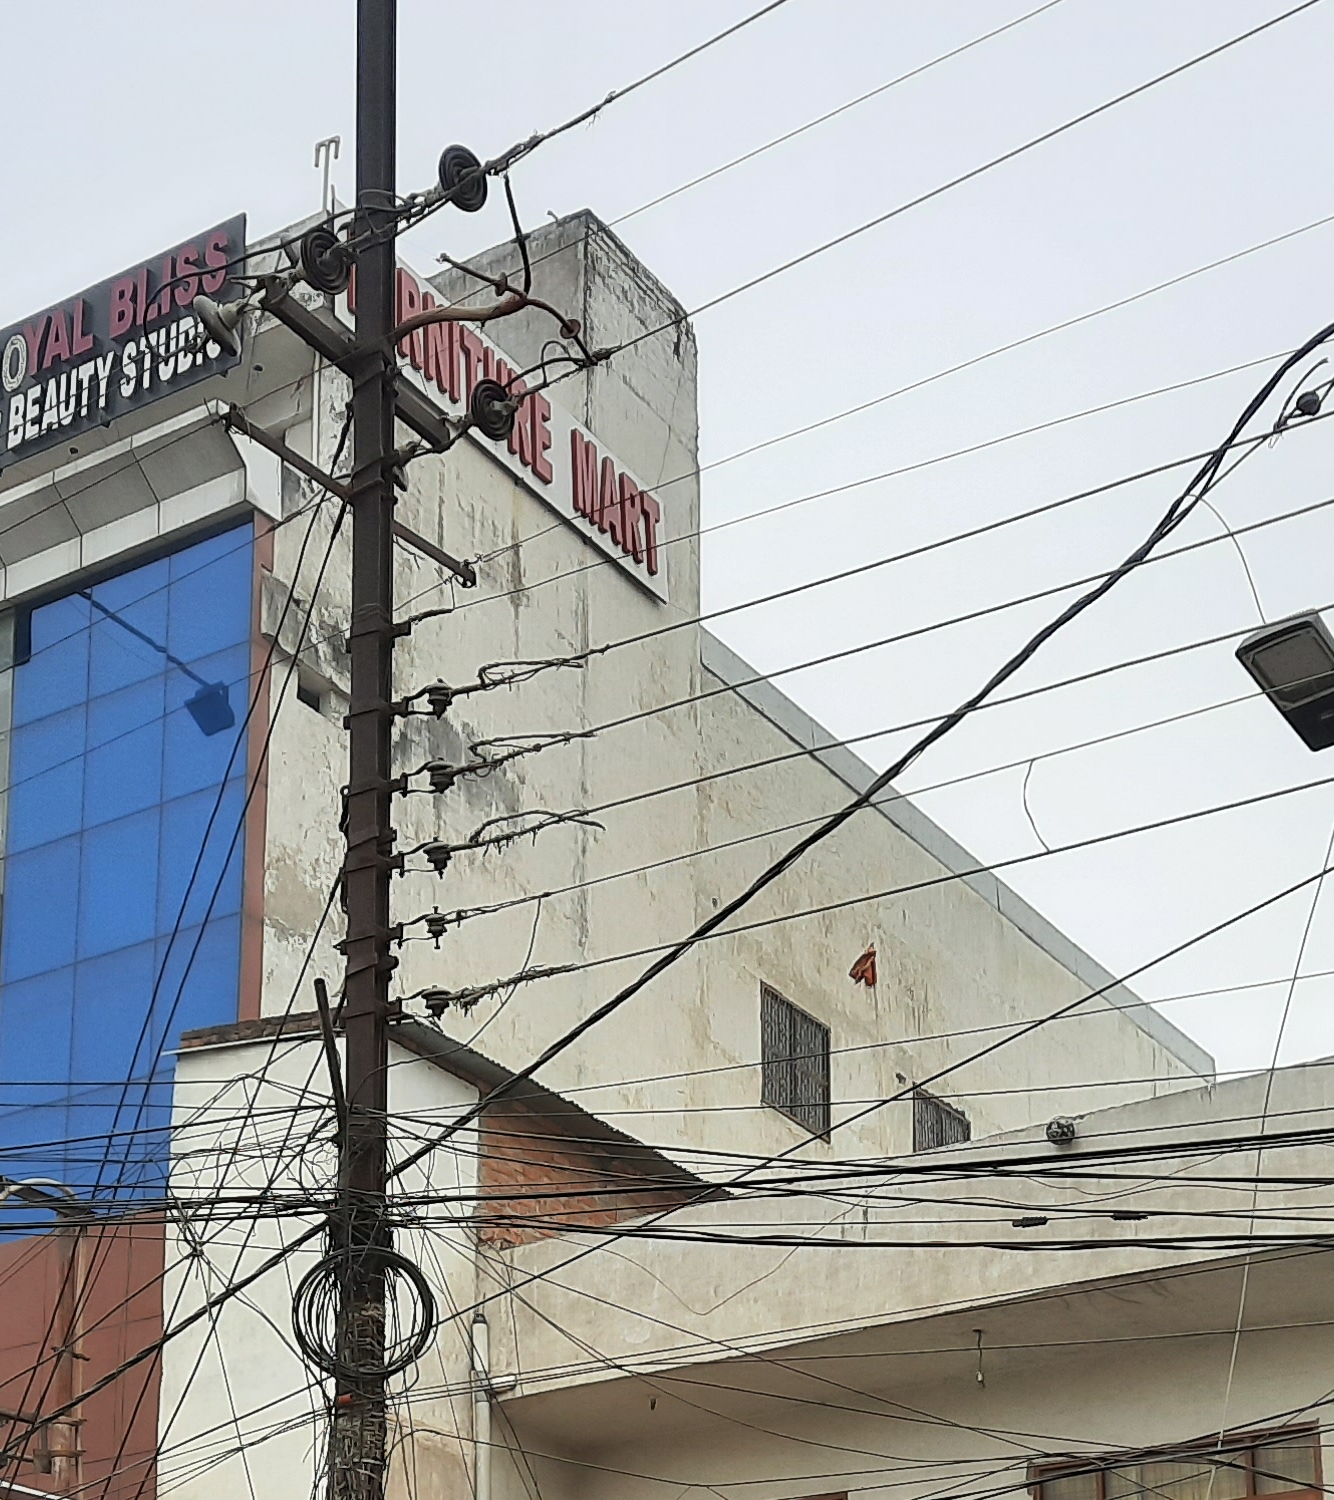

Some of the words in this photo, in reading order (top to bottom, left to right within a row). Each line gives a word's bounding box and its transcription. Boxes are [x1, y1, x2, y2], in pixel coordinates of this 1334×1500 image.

[109, 229, 230, 338] BLISS
[7, 350, 116, 450] BEAUTY
[571, 428, 660, 576] MART
